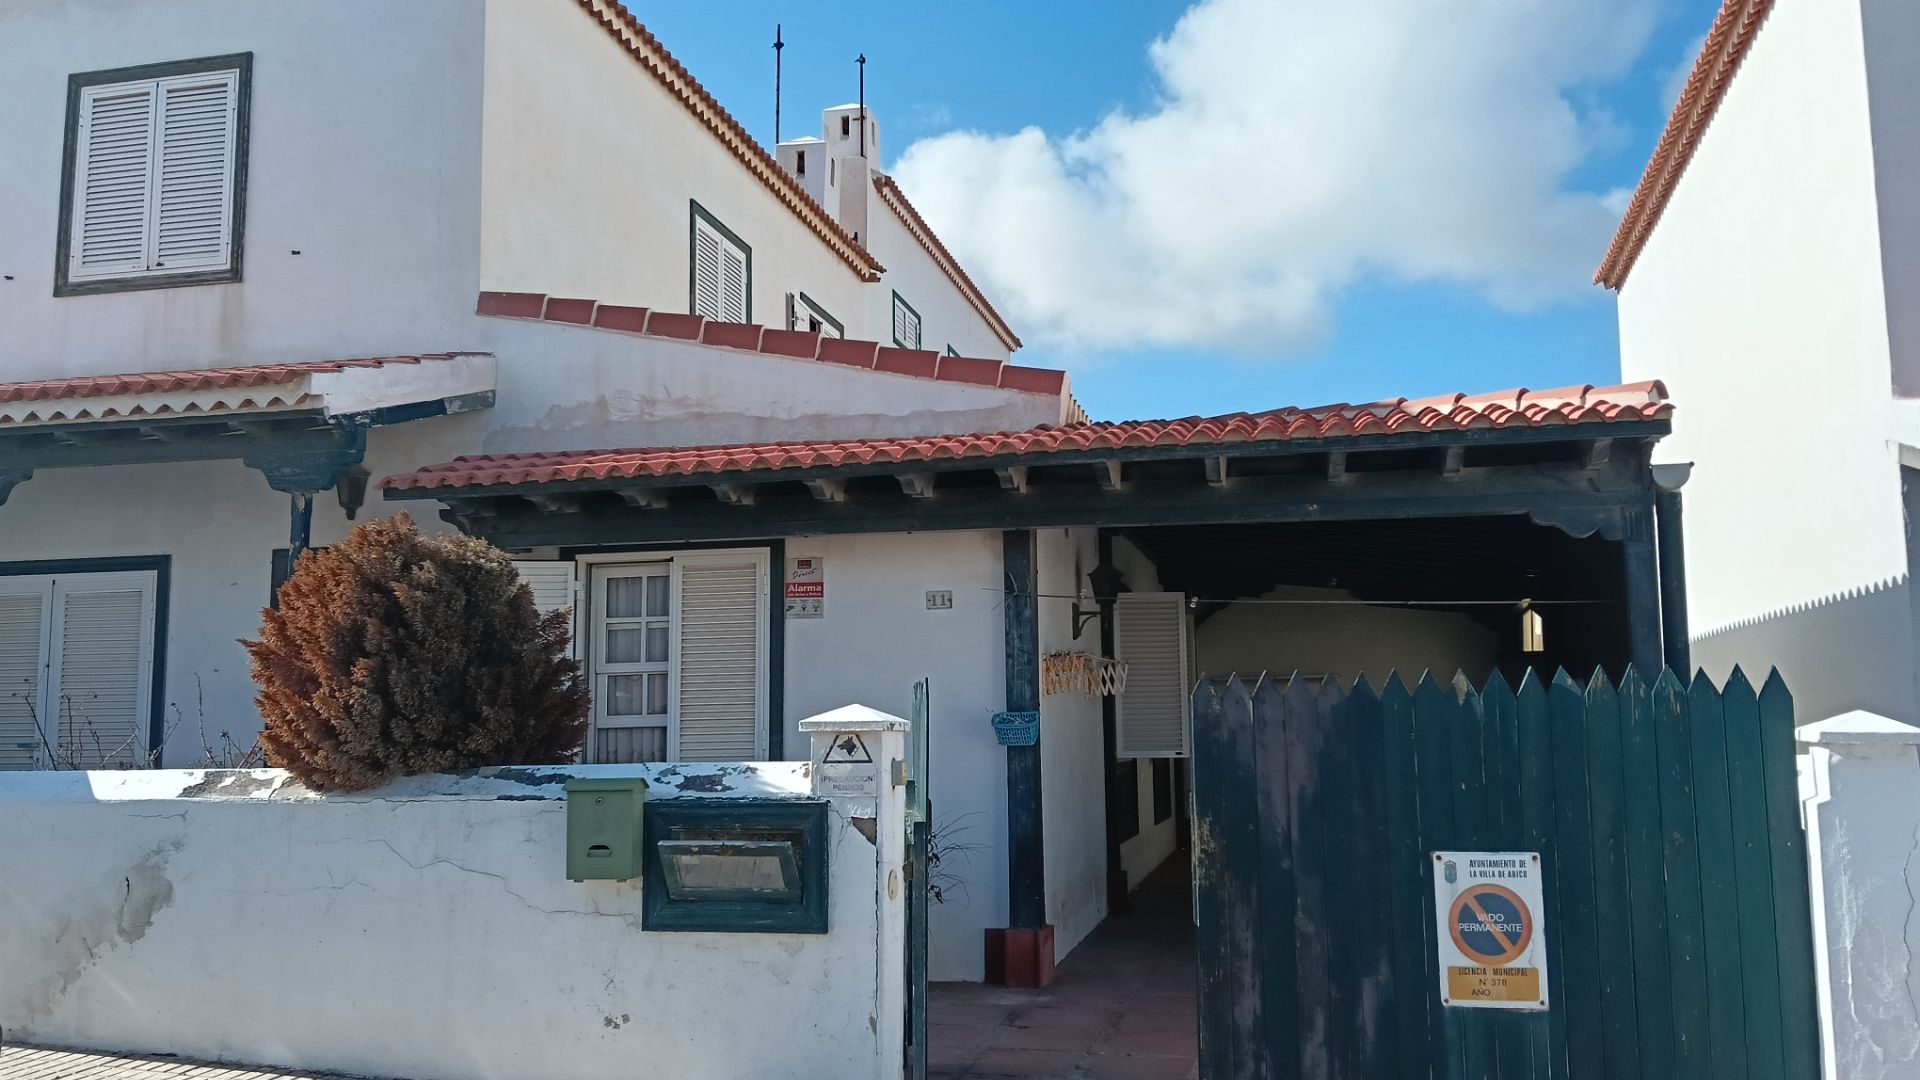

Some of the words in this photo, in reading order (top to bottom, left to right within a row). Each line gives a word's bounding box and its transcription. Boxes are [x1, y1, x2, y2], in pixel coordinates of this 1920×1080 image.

[788, 584, 822, 592] Alarma
[931, 594, 946, 606] 11
[1469, 859, 1516, 868] AYUNTAMIENTO
[1519, 860, 1527, 868] DE
[1469, 870, 1477, 878] LA
[1479, 870, 1495, 878] VILLA
[1498, 870, 1506, 878] DE
[1476, 913, 1504, 922] VADO
[1459, 923, 1522, 932] PERMANENTE
[1458, 967, 1487, 976] LICENCIA
[1492, 968, 1528, 976] MUNICIPAL
[1491, 978, 1507, 987] 378
[1472, 987, 1491, 996] AÑO
